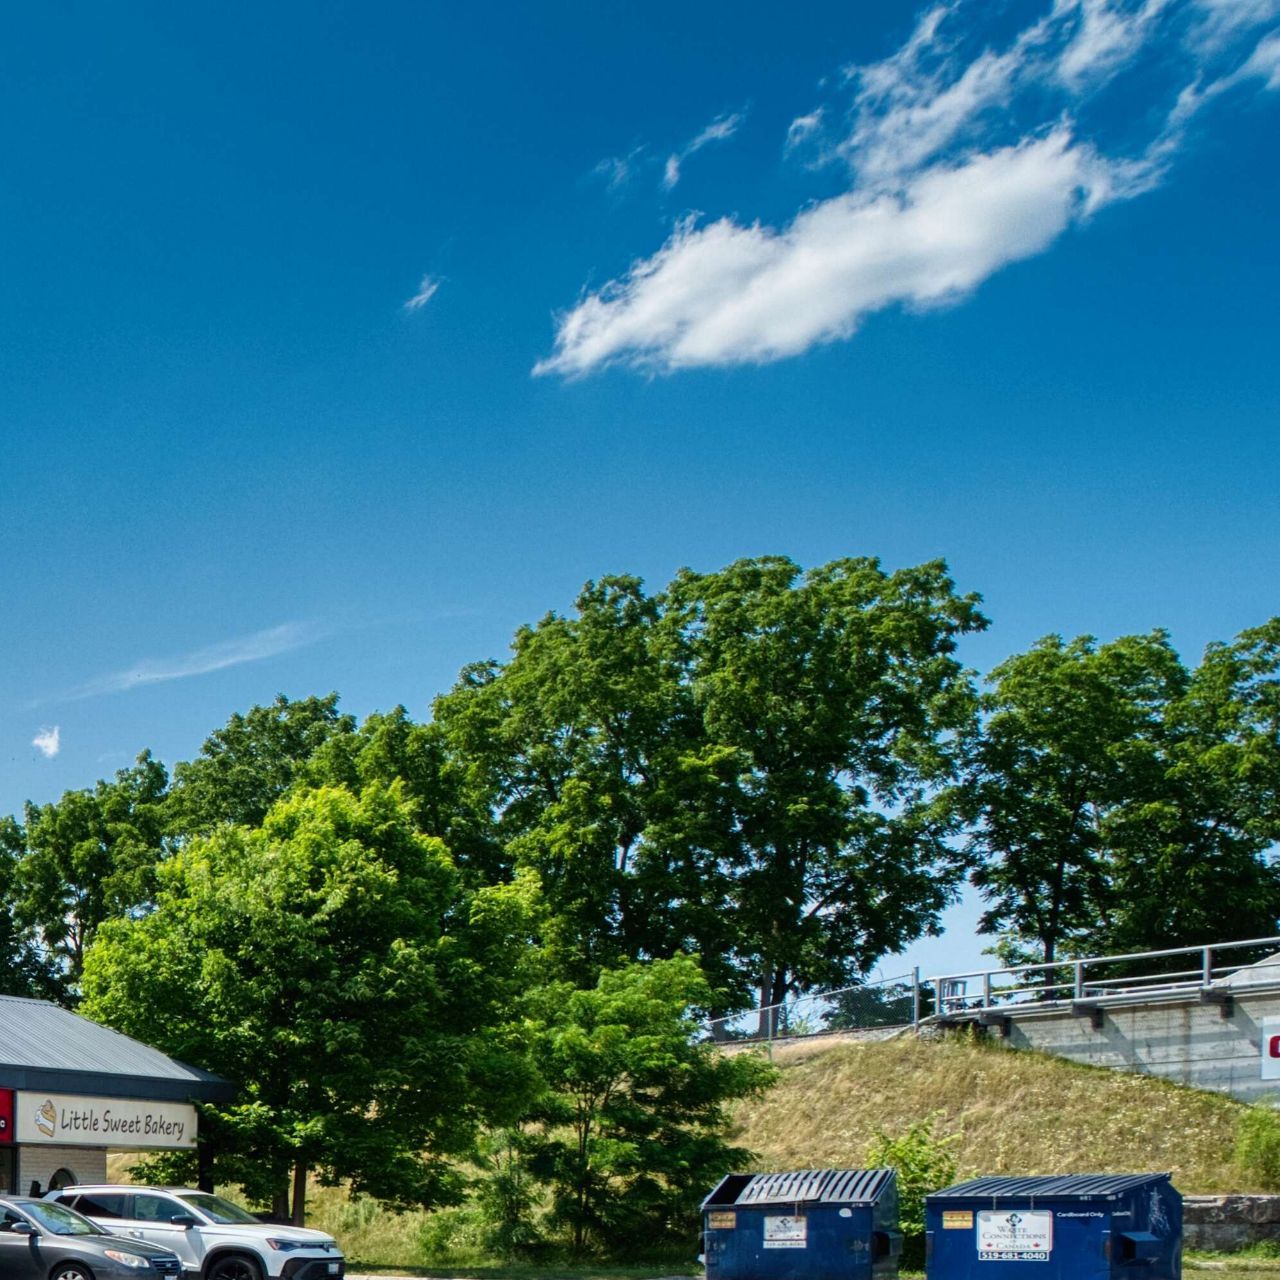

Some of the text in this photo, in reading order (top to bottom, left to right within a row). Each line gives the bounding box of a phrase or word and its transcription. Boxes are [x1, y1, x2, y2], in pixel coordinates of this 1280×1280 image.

[61, 1108, 185, 1141] Little Sweet Bakery
[981, 1252, 1046, 1260] 519-681-4040
